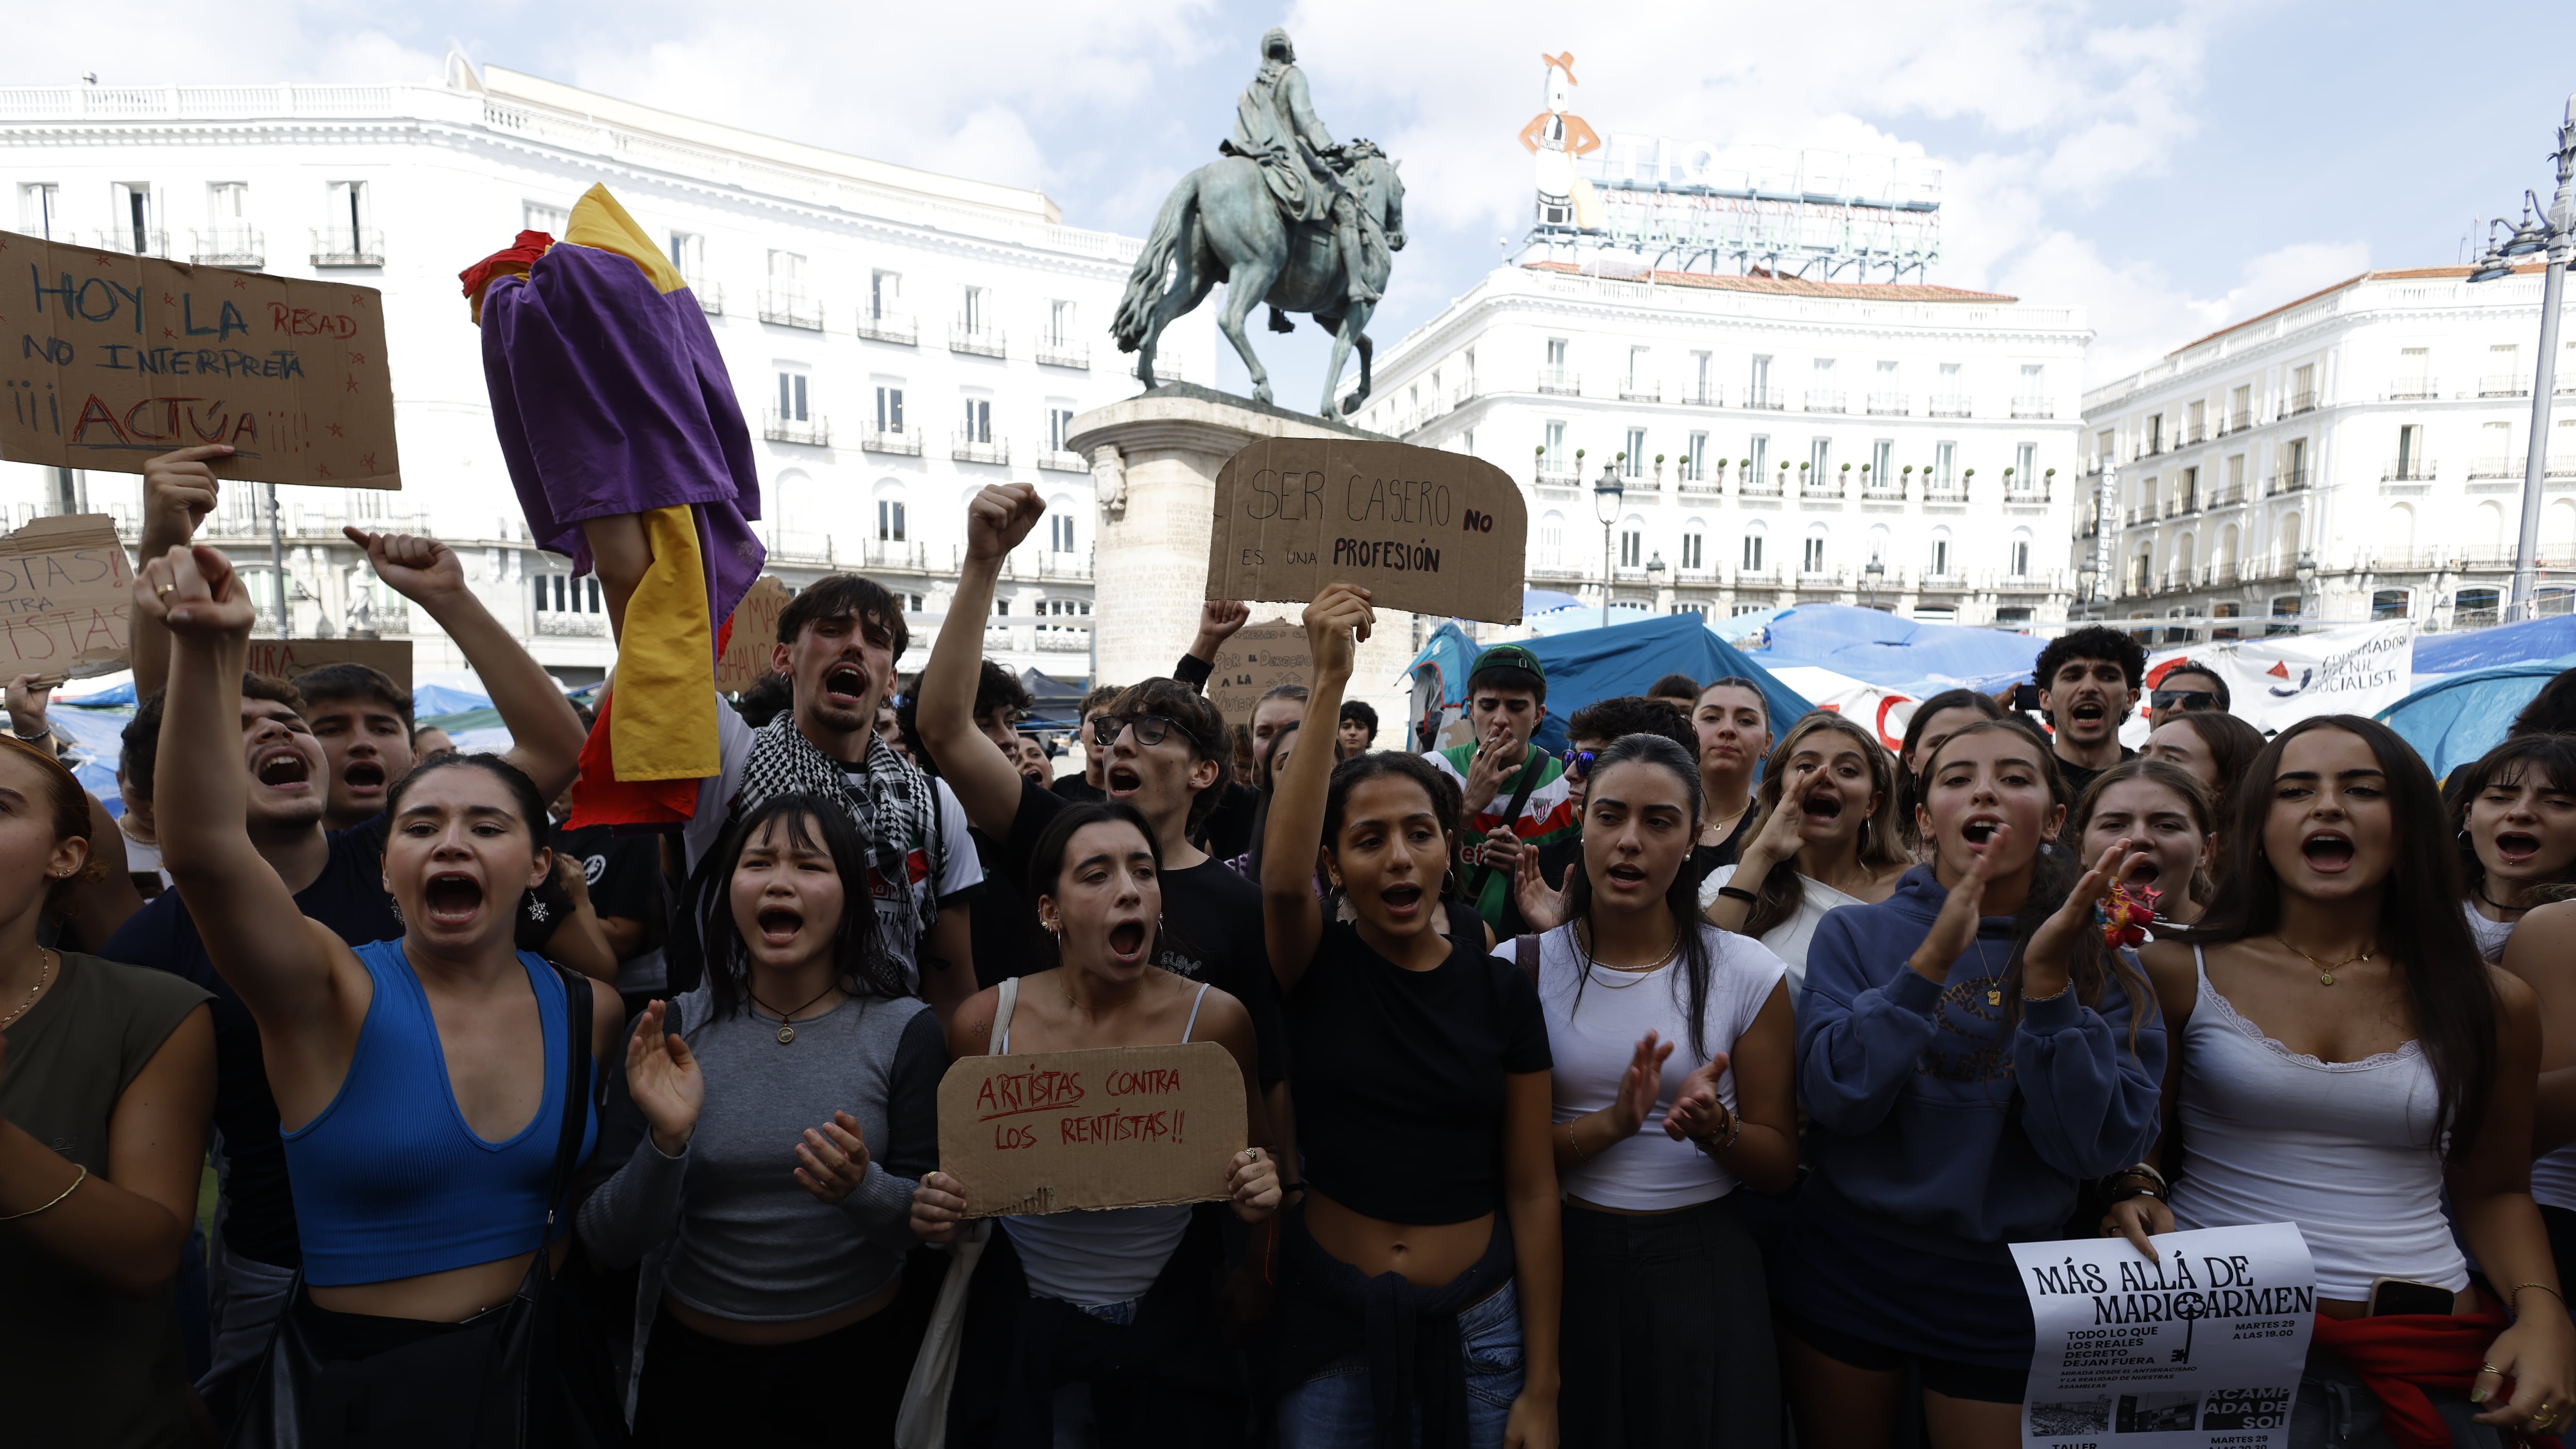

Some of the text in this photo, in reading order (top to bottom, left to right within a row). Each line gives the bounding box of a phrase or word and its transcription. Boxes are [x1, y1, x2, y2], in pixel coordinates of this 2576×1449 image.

[1606, 132, 1946, 202] TIO PEPE
[1605, 189, 1646, 206] SOL
[1652, 193, 1677, 207] DE
[1837, 221, 1943, 265] BYASS
[31, 263, 358, 343] HOY LA RESAD
[22, 334, 305, 379] NO INTERPRETA
[1247, 469, 1493, 533] SER CASERO NO
[2096, 463, 2115, 596] HOTEL EUROPA
[1242, 538, 1440, 572] ES UNA PROFESIÓN
[1243, 630, 1279, 640] RESAD
[1213, 650, 1313, 674] POR EL DERECHO
[1221, 674, 1252, 687] A LA
[1160, 950, 1202, 975] SLOW
[1106, 1069, 1180, 1097] CONTRA
[994, 1123, 1037, 1151] LOS
[2032, 1250, 2254, 1295] MÁS ALLÁ DE
[2067, 1326, 2159, 1340] TODO LO QUE
[2235, 1320, 2295, 1331] MARTES 29
[2265, 1329, 2294, 1338] 19.00
[2064, 1349, 2128, 1359] DECRETO
[2066, 1338, 2144, 1351] LOS REALES
[2062, 1356, 2155, 1367] DEJAN FUERA
[2204, 1401, 2289, 1414] ADA DE
[2242, 1416, 2284, 1430] SOL
[2210, 1436, 2252, 1444] MARTES
